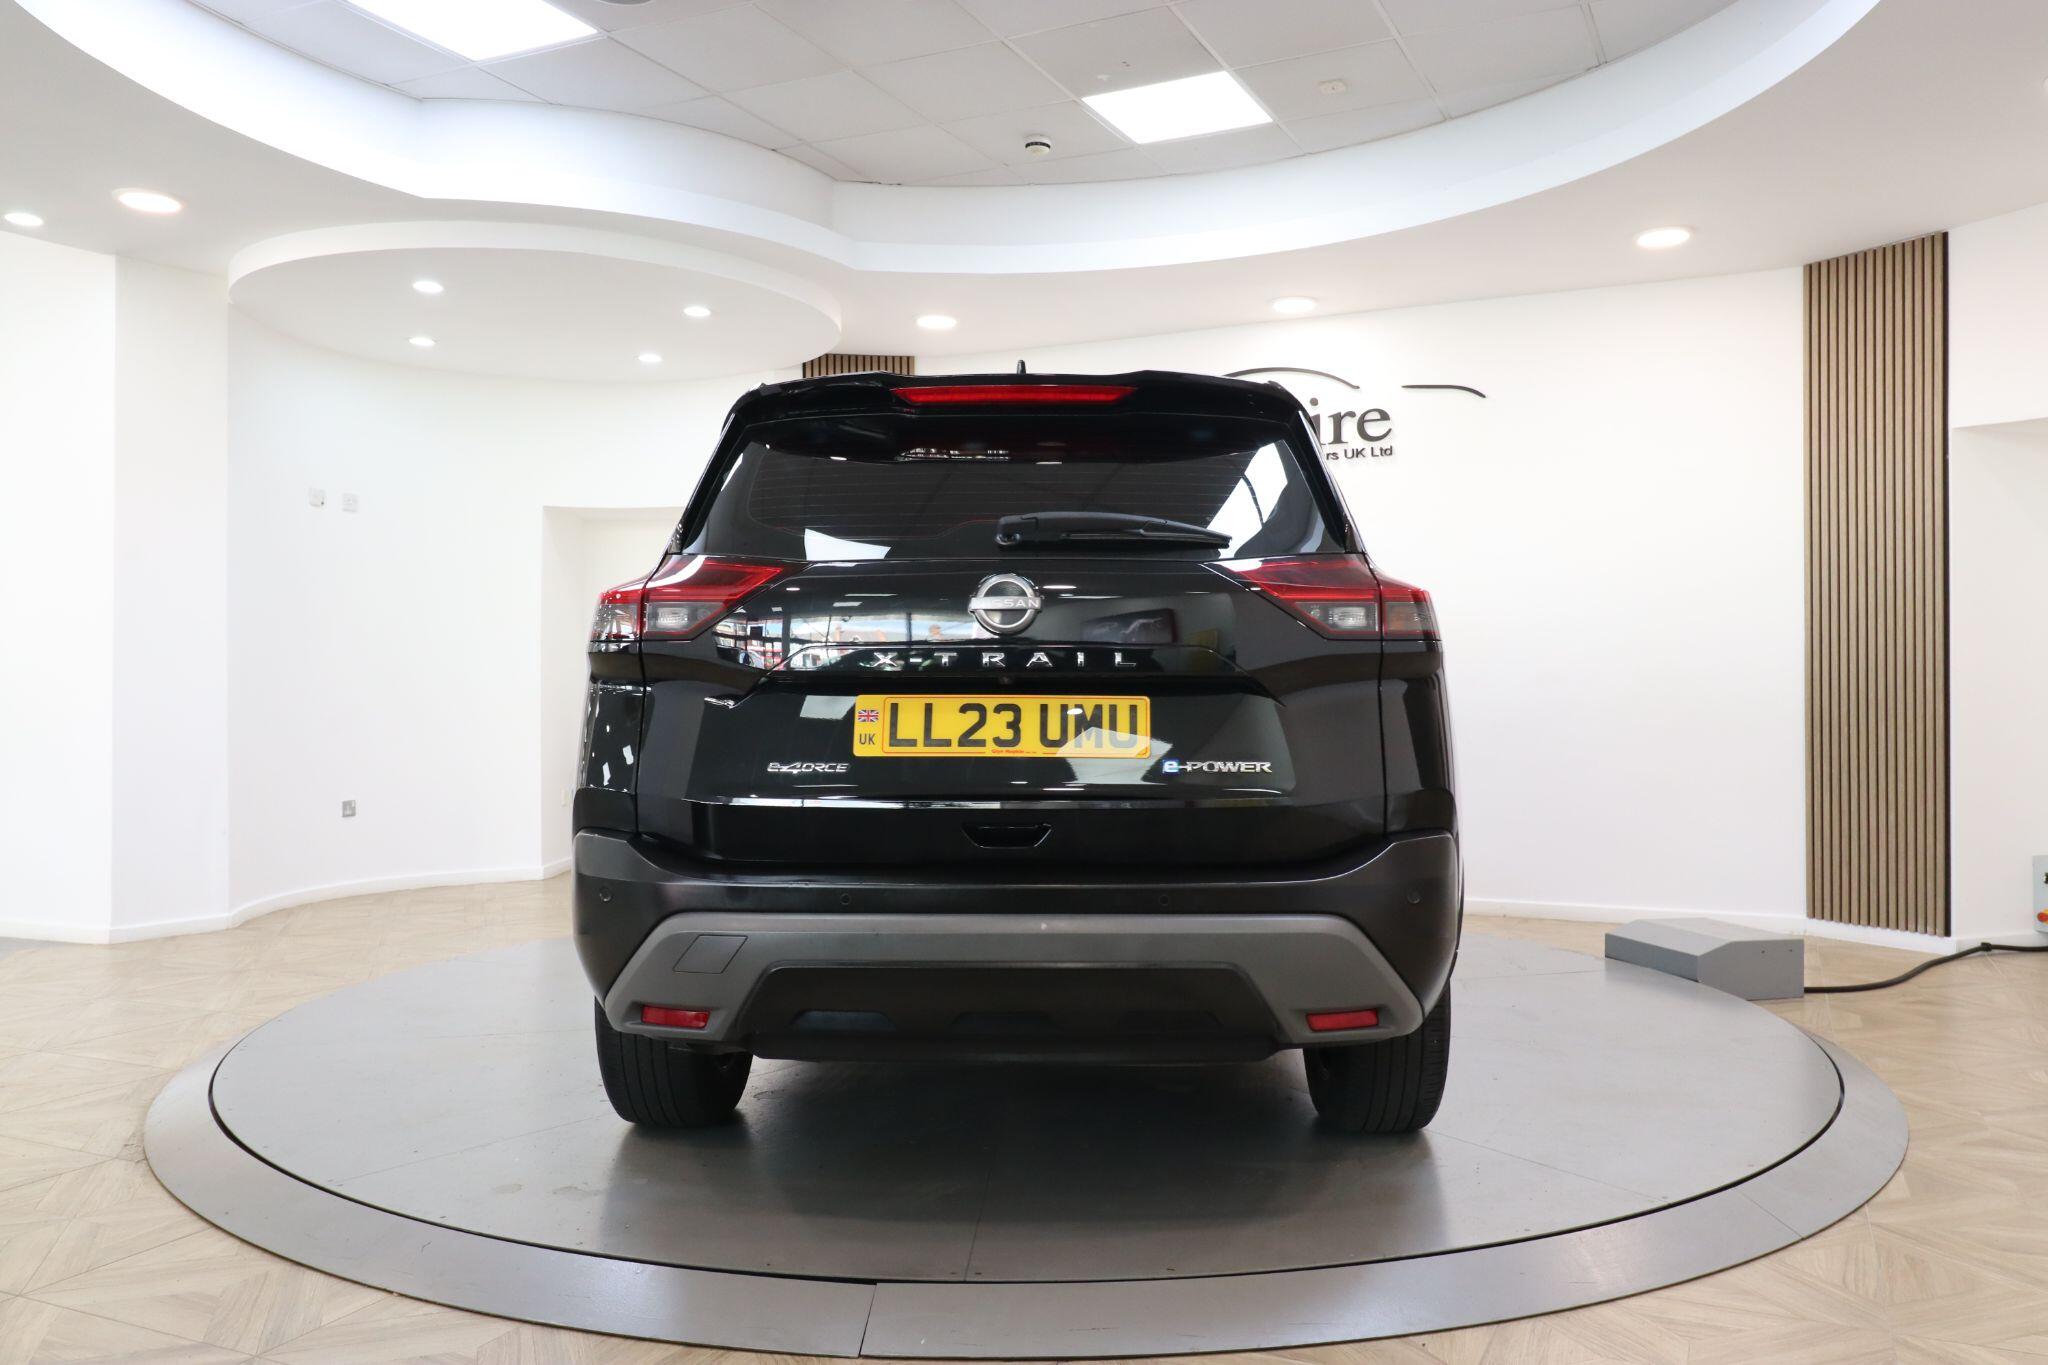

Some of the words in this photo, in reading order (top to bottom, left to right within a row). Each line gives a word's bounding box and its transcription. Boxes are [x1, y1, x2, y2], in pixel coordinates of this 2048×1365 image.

[1309, 397, 1392, 445] ire
[1325, 451, 1340, 461] rs
[1344, 447, 1366, 459] UK
[1370, 445, 1393, 457] Ltd
[973, 599, 1039, 608] SSAN
[873, 652, 1137, 667] X-TRAIL
[889, 703, 1022, 748] LL23
[1040, 703, 1138, 749] UMU
[858, 733, 875, 745] UK
[1162, 760, 1273, 773] e-POWER
